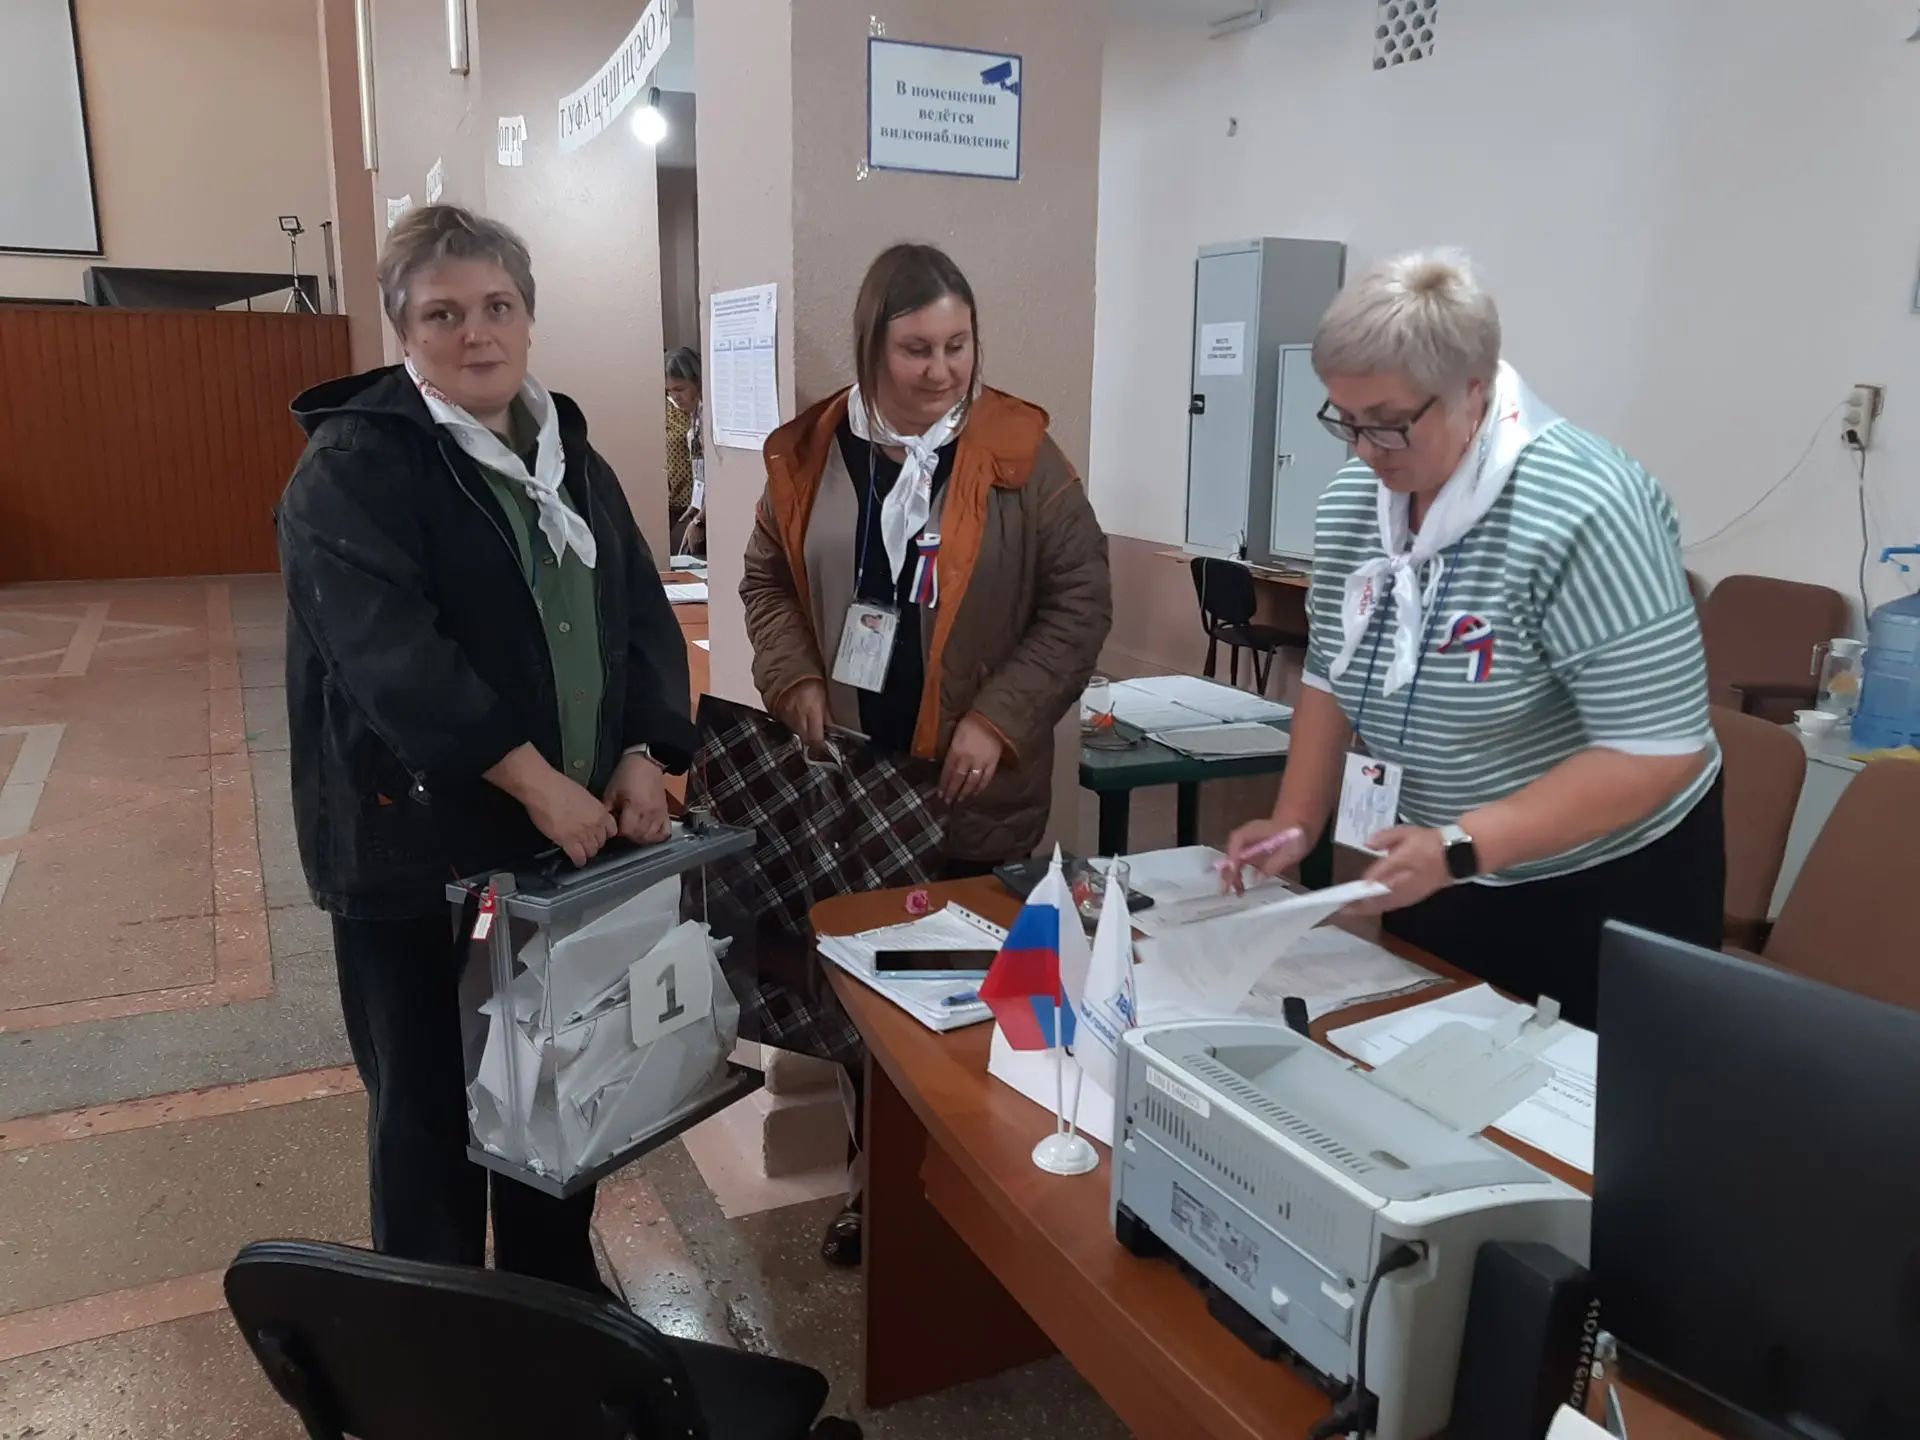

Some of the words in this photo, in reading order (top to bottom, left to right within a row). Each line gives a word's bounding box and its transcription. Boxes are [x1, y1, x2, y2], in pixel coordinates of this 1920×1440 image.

[896, 79, 907, 96] В
[911, 85, 997, 105] помещении
[918, 106, 975, 125] ведётся
[880, 126, 1011, 150] видеонаблюдение
[656, 963, 685, 1024] 1
